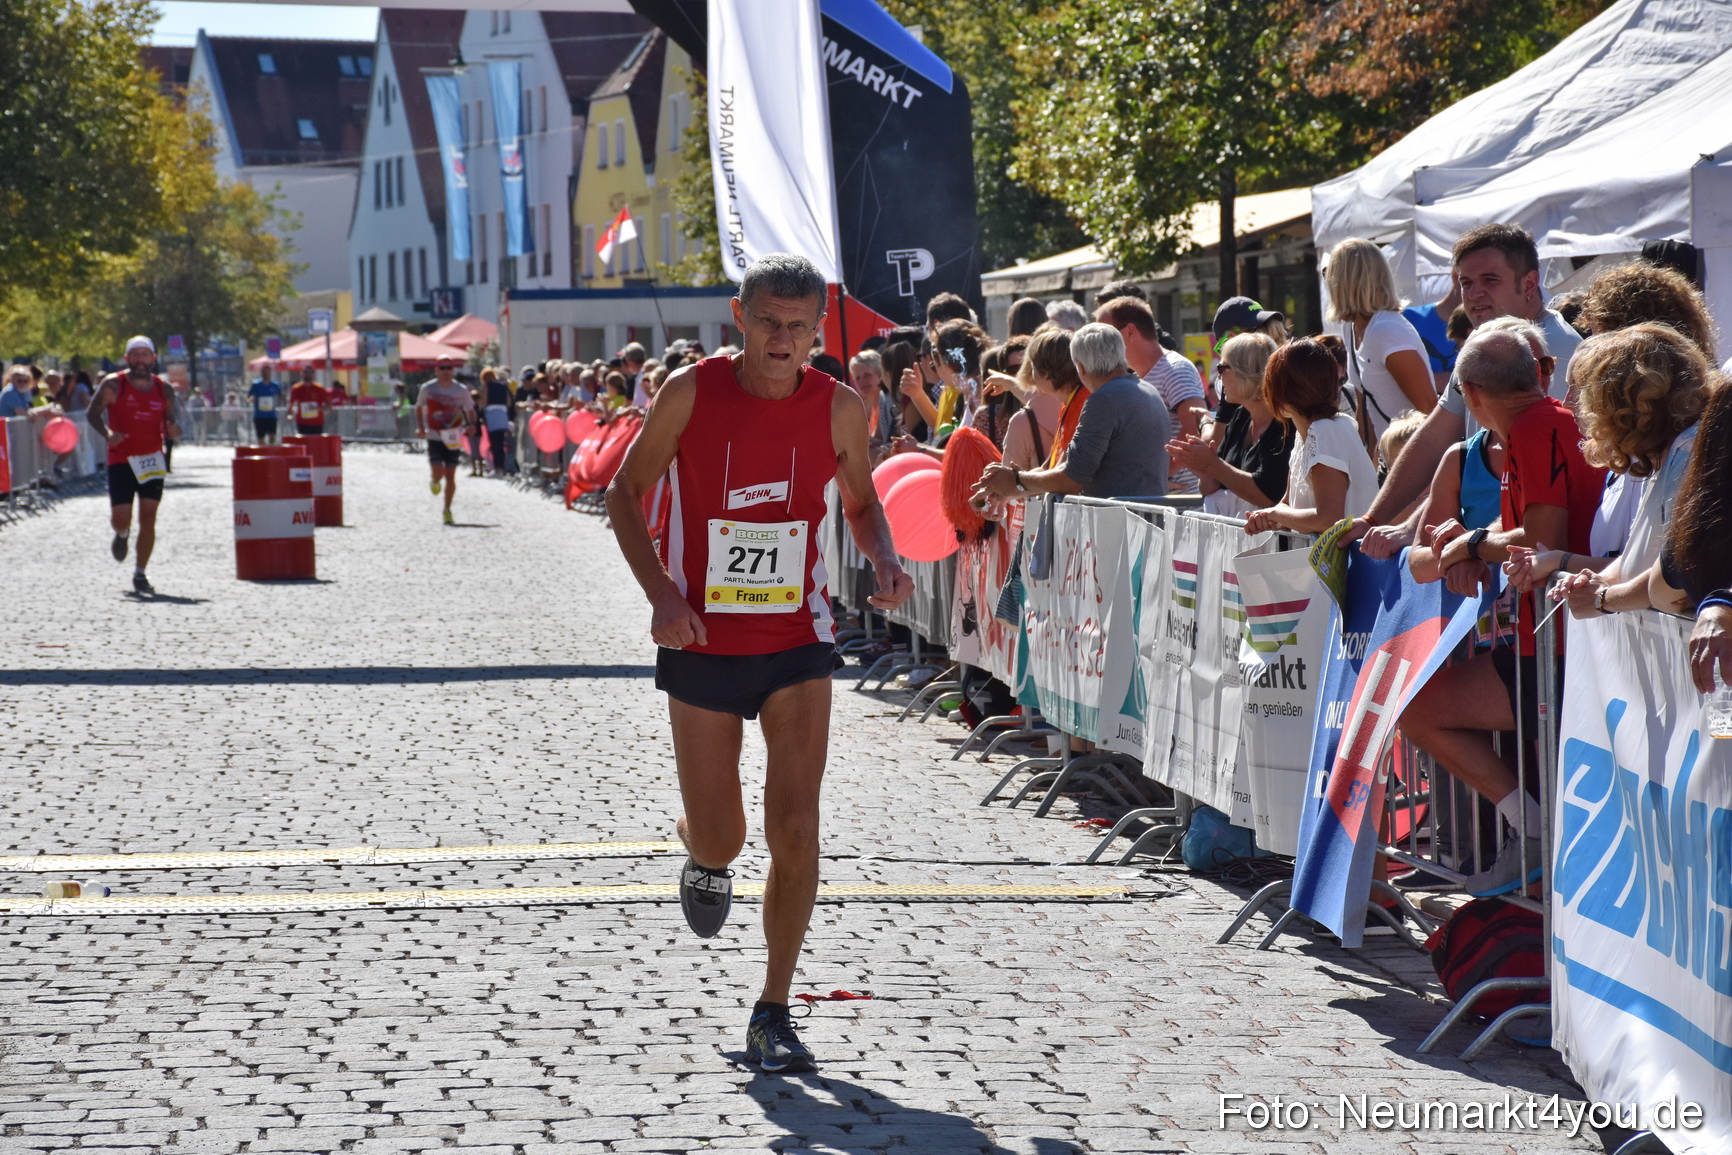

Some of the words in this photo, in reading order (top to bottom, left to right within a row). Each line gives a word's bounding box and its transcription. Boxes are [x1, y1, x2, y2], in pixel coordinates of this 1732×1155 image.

[139, 457, 157, 470] 222
[744, 488, 772, 502] DEHN
[735, 528, 780, 541] BOCK
[1311, 518, 1351, 567] URKUNDE
[727, 546, 779, 574] 271
[736, 590, 770, 602] Franz
[1264, 701, 1303, 718] genießen
